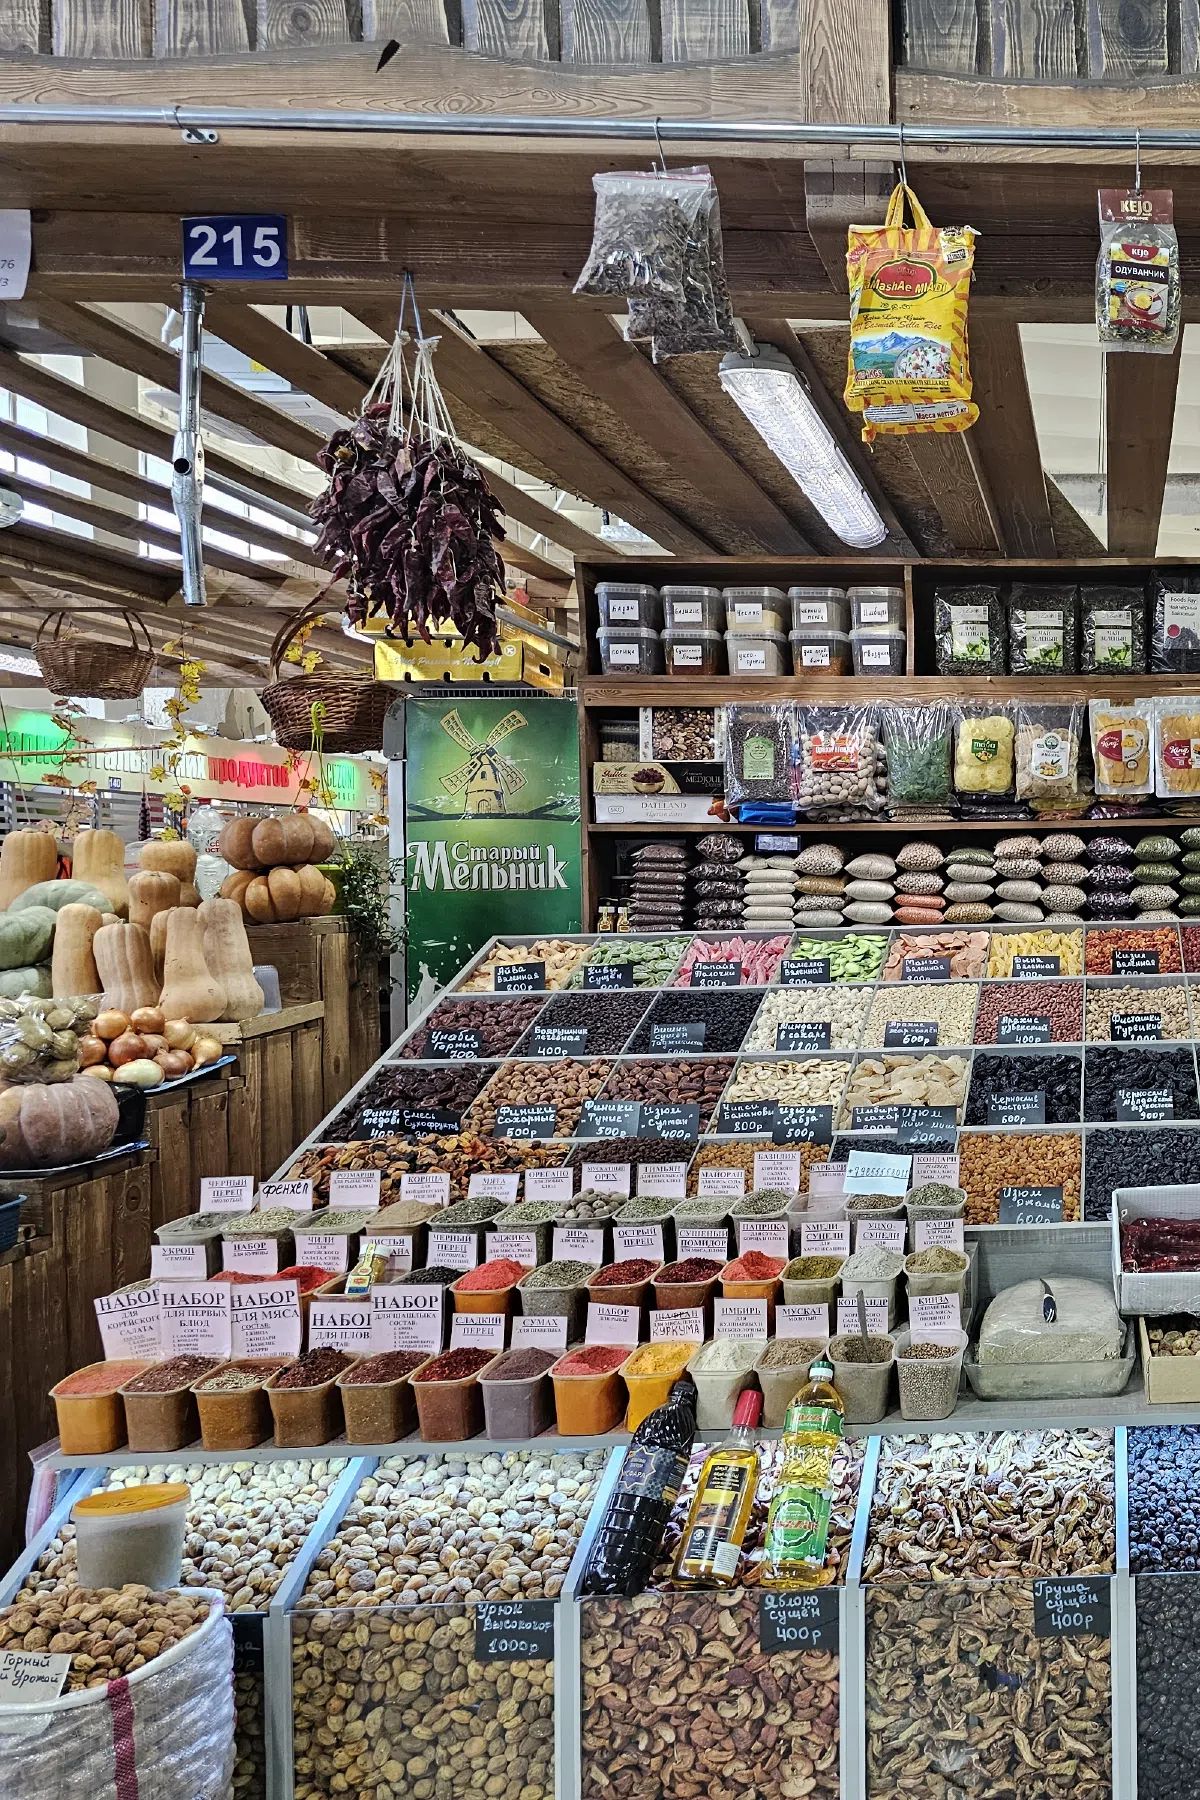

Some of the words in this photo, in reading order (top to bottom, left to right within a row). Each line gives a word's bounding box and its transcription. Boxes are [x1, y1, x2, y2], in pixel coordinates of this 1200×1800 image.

[1121, 200, 1152, 216] KEJO
[189, 225, 281, 268] 215
[1132, 248, 1149, 258] KEJO
[1115, 265, 1165, 278] ОДУВАНЧИК
[208, 757, 289, 788] продуктов
[452, 840, 542, 864] Старый
[407, 841, 570, 891] Мельник
[538, 1046, 568, 1056] 400р
[734, 1122, 763, 1132] 800р
[506, 1128, 538, 1137] 500р
[660, 1130, 691, 1140] 400р
[786, 1129, 815, 1140] 500р
[528, 1170, 569, 1178] ОРЕГАНО
[208, 1178, 247, 1187] ЧЕРНЫЙ
[618, 1228, 657, 1236] ОСТРЫЙ
[742, 1223, 786, 1231] ПАПРИКА
[308, 1236, 334, 1245] ЧИЛИ
[433, 1234, 472, 1242] ЧЕРНЫЙ
[491, 1233, 531, 1241] АДЖИКА
[624, 1238, 654, 1246] ПЕРЕЦ
[162, 1247, 195, 1256] УКРОП
[233, 1242, 267, 1251] НАБОР
[162, 1292, 225, 1306] НАБОР
[231, 1290, 296, 1308] НАБОР
[373, 1295, 439, 1309] НАБОР
[918, 1296, 949, 1304] КИНЗА
[163, 1310, 185, 1318] ДЛЯ
[188, 1309, 228, 1318] ПЕРВЫХ
[261, 1308, 299, 1320] МЯСА
[598, 1308, 629, 1316] НАБОР
[782, 1307, 822, 1315] МУСКАТ
[179, 1319, 210, 1328] БЛЮД
[455, 1316, 501, 1324] СЛАДКИЙ
[522, 1318, 558, 1326] СУМАХ
[463, 1326, 494, 1334] ПЕРЕЦ
[652, 1324, 700, 1336] КУРКУМА
[1034, 1581, 1091, 1597] Груша
[1051, 1613, 1093, 1630] 400р
[777, 1627, 821, 1645] 400р
[489, 1638, 539, 1655] 1000р
[4, 1653, 52, 1671] Горный
